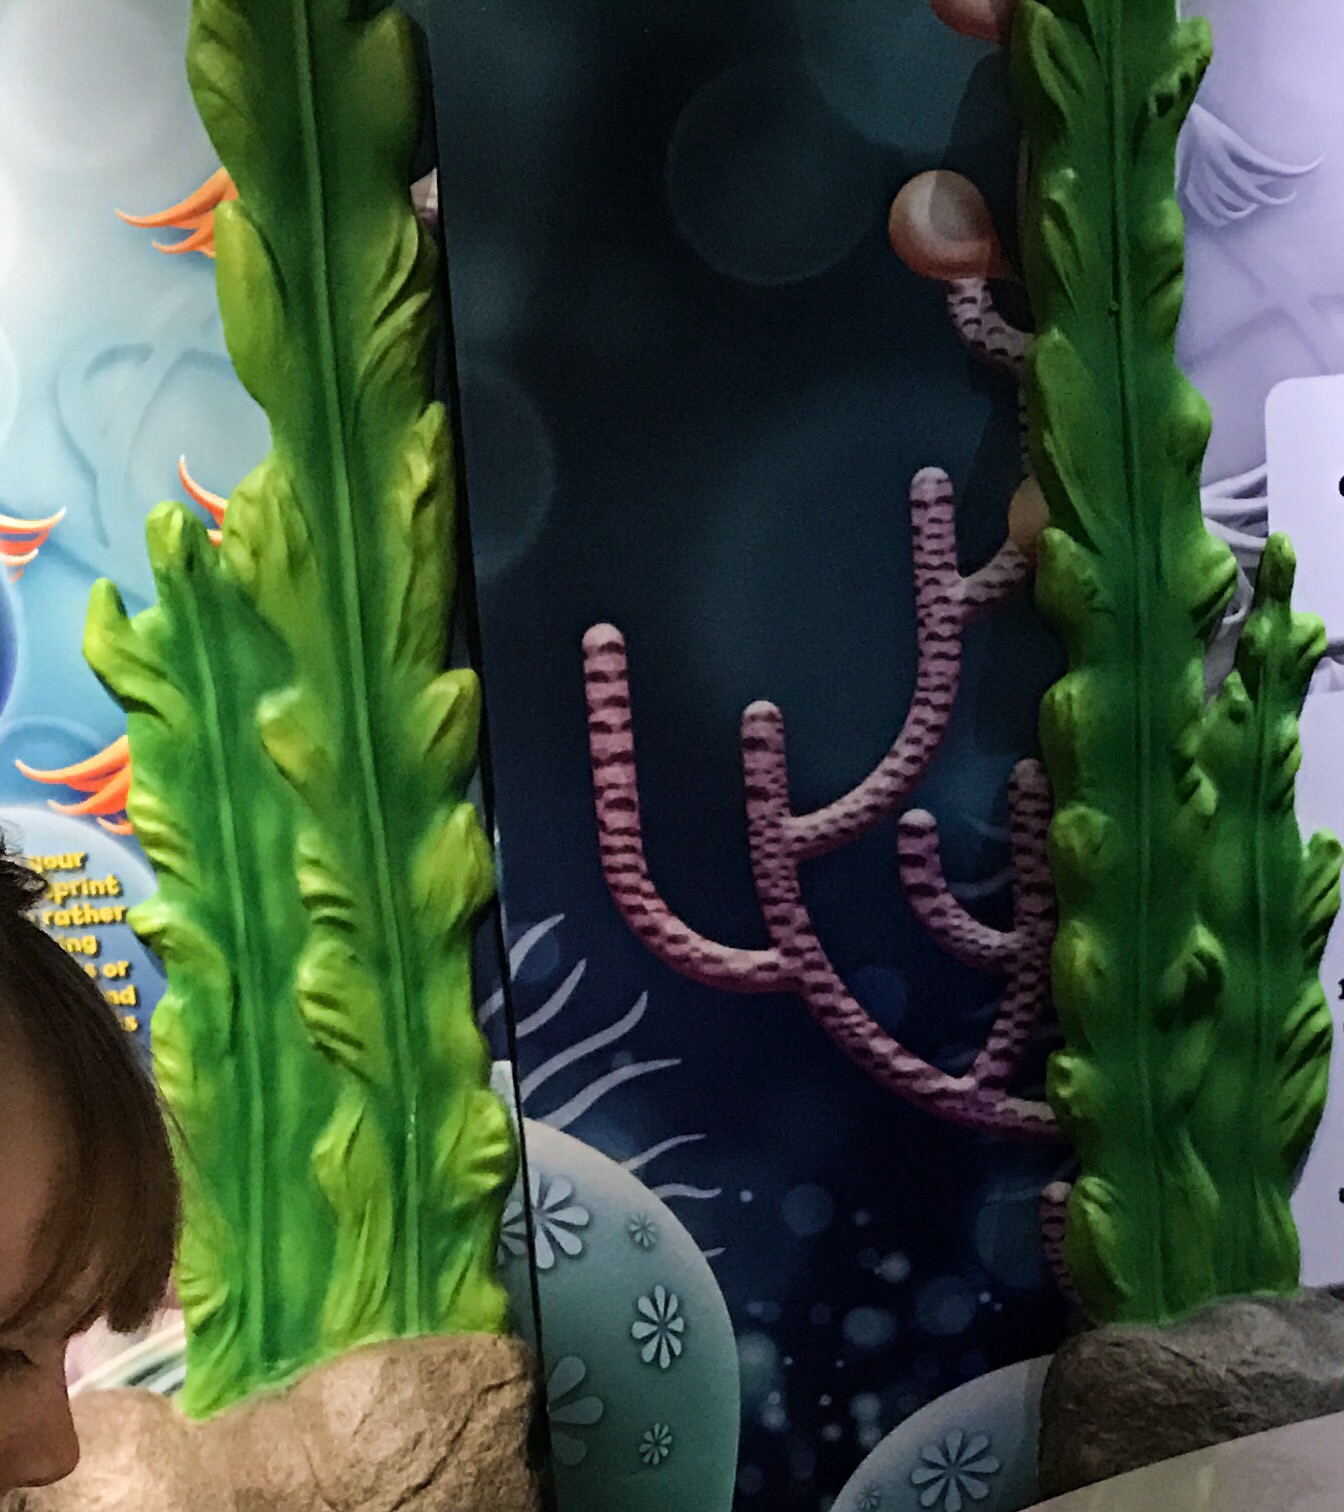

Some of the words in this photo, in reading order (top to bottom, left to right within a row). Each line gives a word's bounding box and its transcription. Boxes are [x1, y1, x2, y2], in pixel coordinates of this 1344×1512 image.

[27, 852, 85, 873] your
[42, 903, 127, 927] rather
[103, 960, 129, 978] or
